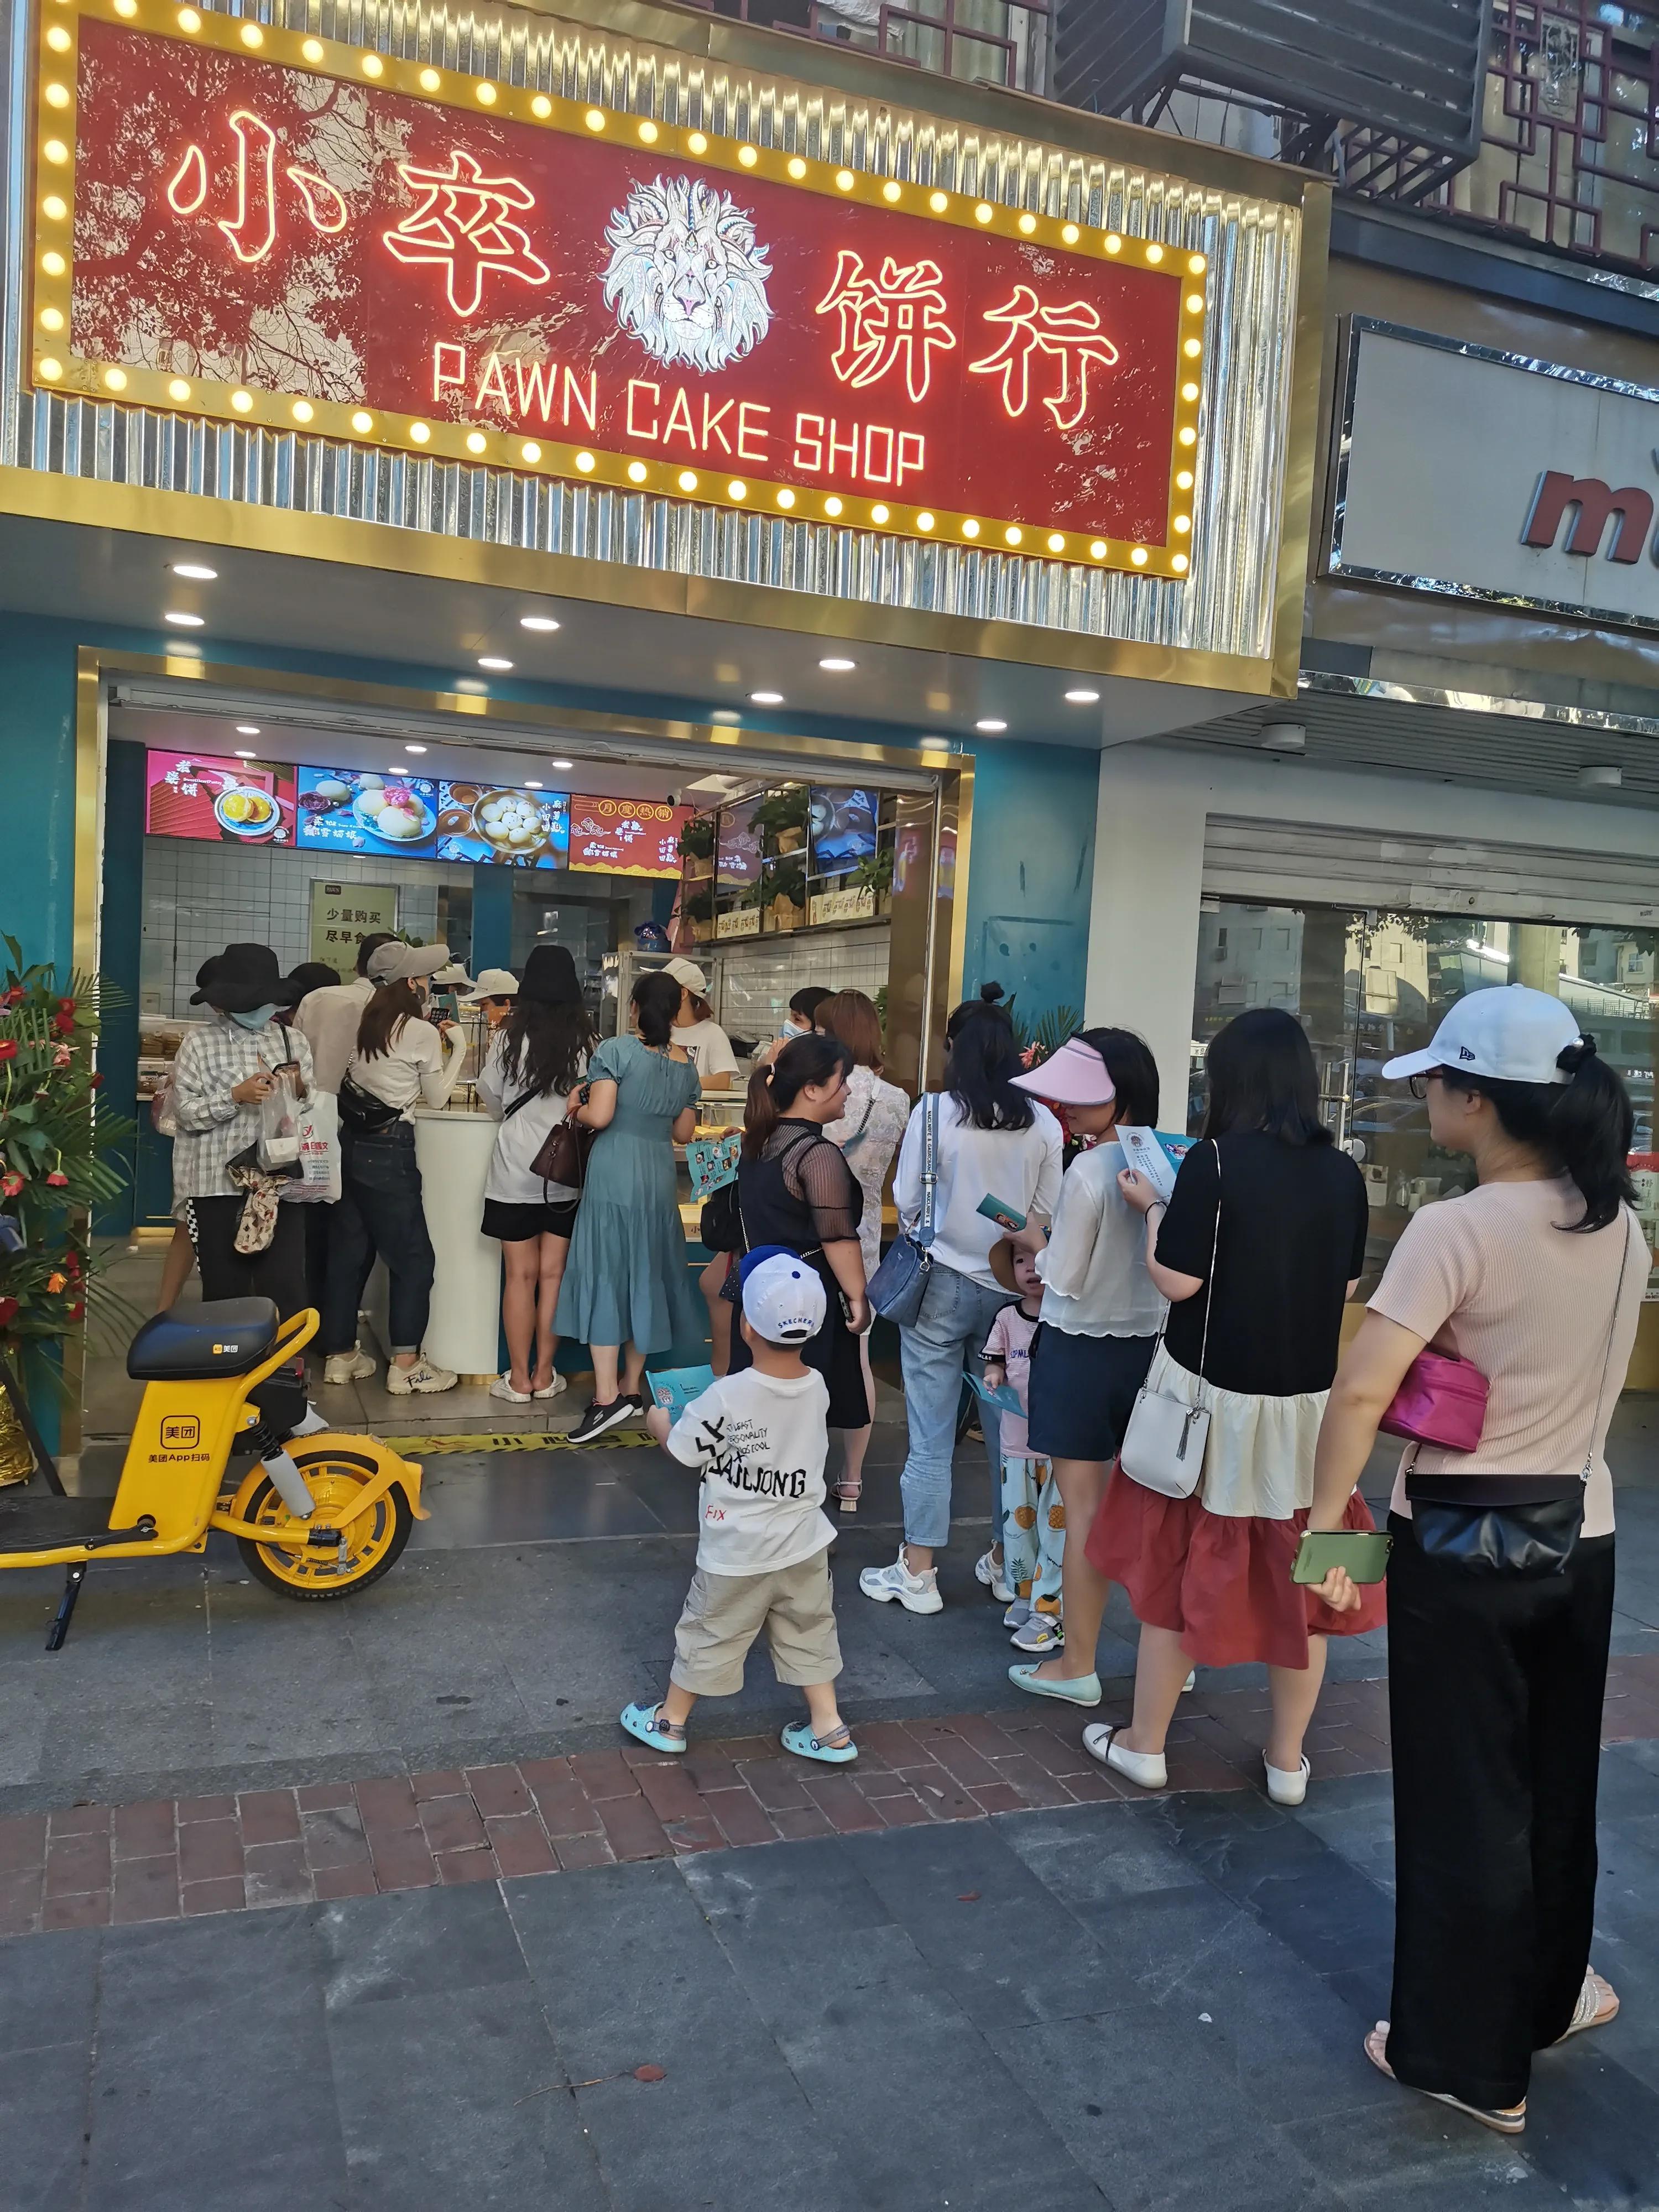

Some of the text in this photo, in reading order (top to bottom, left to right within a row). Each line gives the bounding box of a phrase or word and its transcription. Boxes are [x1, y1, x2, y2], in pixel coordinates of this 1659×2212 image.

[167, 109, 1119, 430] 小卒 饼行
[433, 341, 926, 487] PAWN CAKE SHOP
[326, 907, 382, 924] 少量购买
[165, 1426, 195, 1439] 美团
[148, 1452, 210, 1464] 美团App扫码
